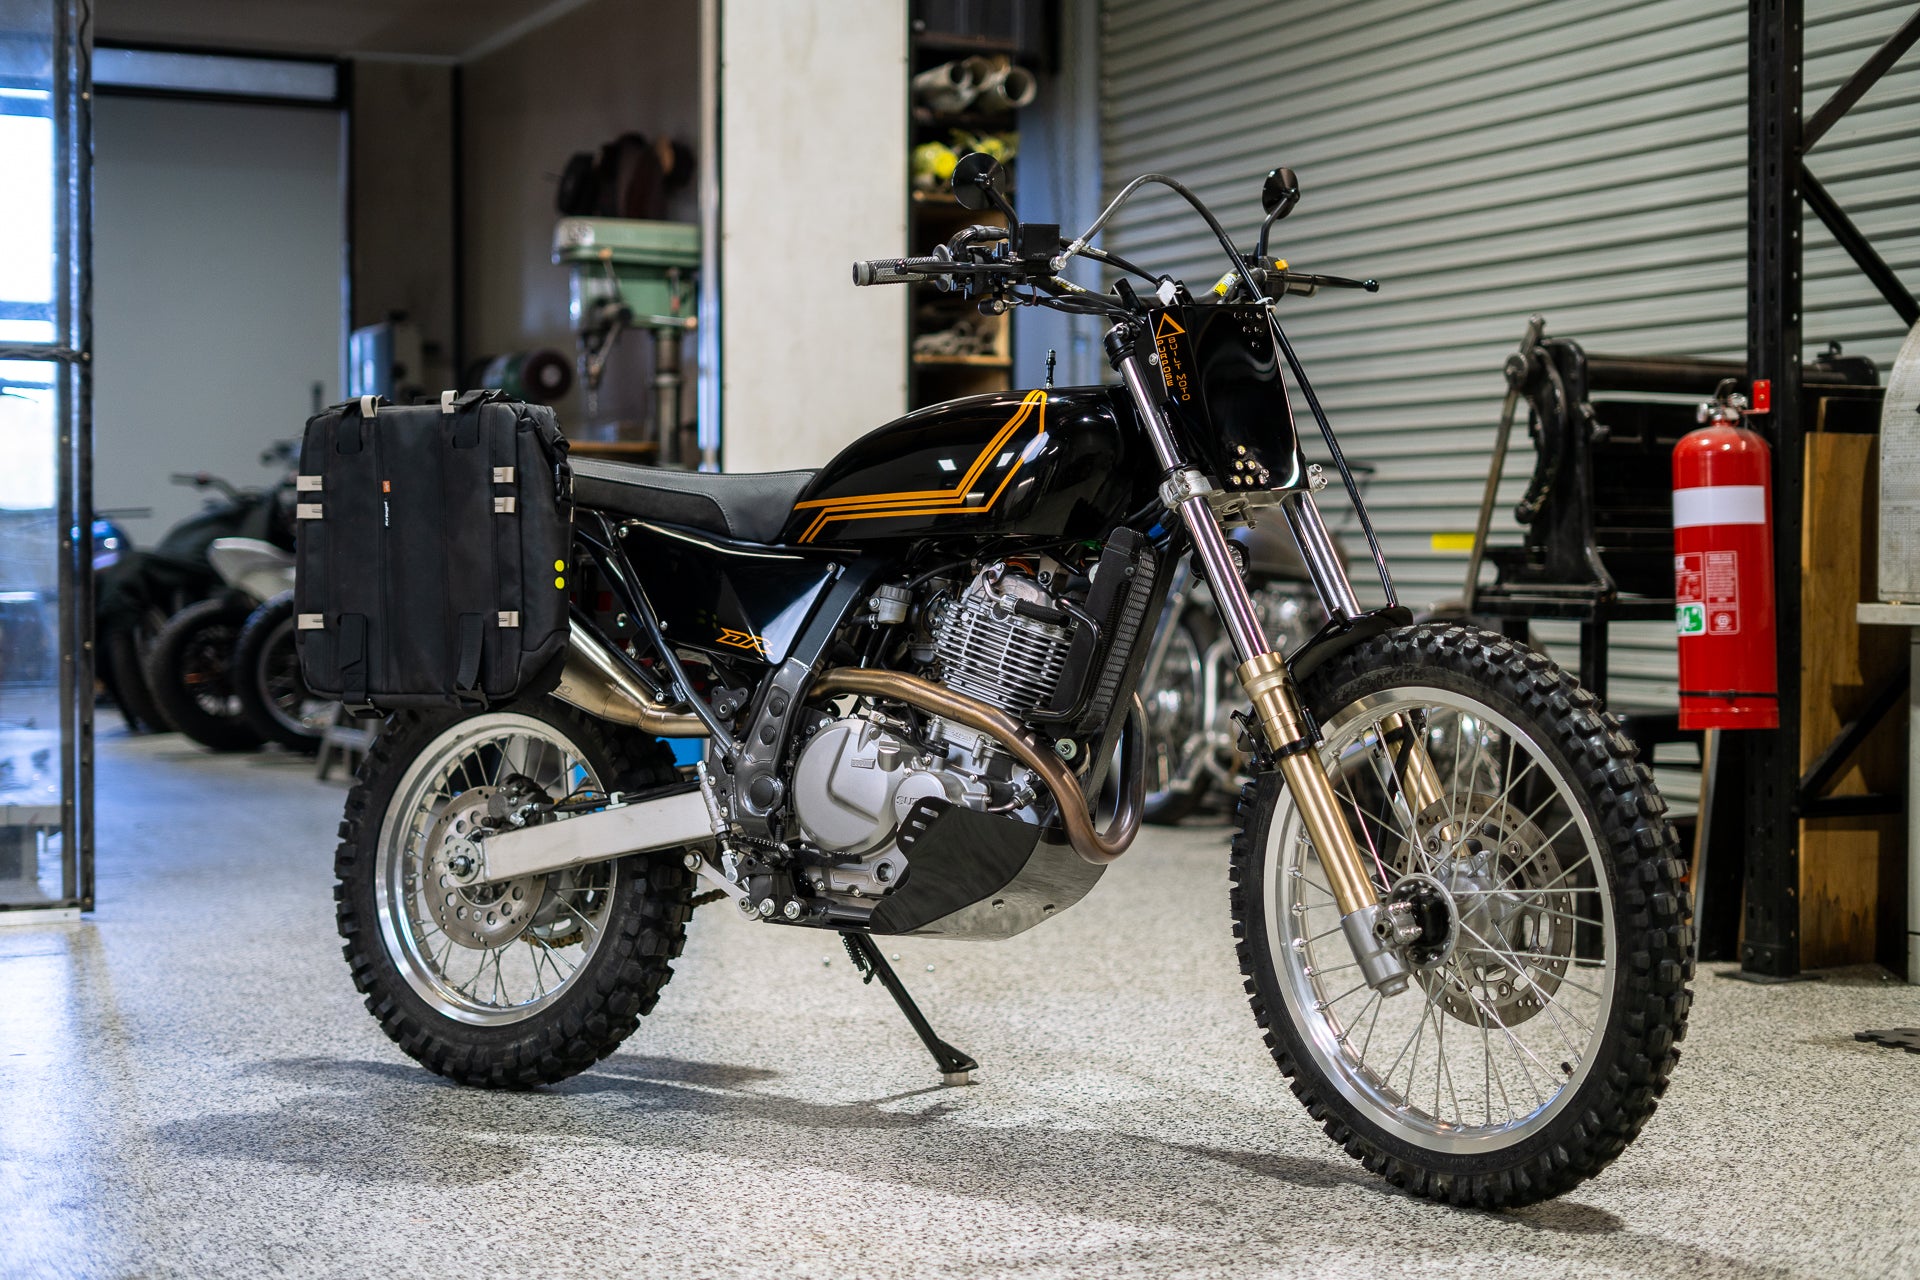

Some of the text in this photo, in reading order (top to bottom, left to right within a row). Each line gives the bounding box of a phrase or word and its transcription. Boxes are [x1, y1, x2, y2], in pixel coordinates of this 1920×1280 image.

[1156, 340, 1174, 387] PURPOSE
[1168, 337, 1191, 401] BUILT MOTO
